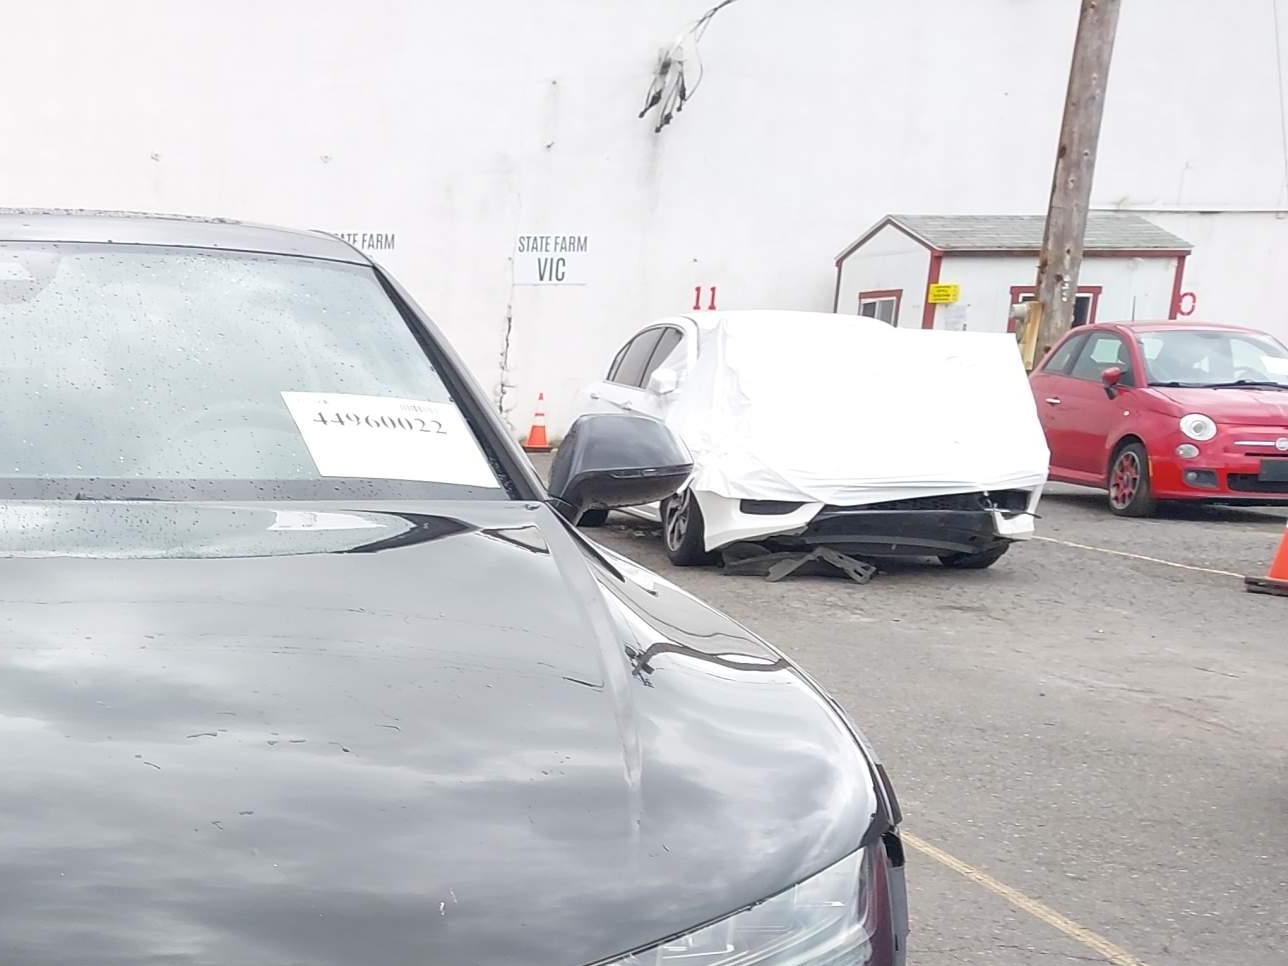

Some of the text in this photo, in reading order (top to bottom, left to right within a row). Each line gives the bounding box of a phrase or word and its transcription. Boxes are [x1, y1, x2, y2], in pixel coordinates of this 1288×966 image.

[362, 233, 395, 250] FARM
[518, 235, 588, 253] STATE FARM
[537, 257, 566, 282] VIC
[693, 286, 717, 310] 11
